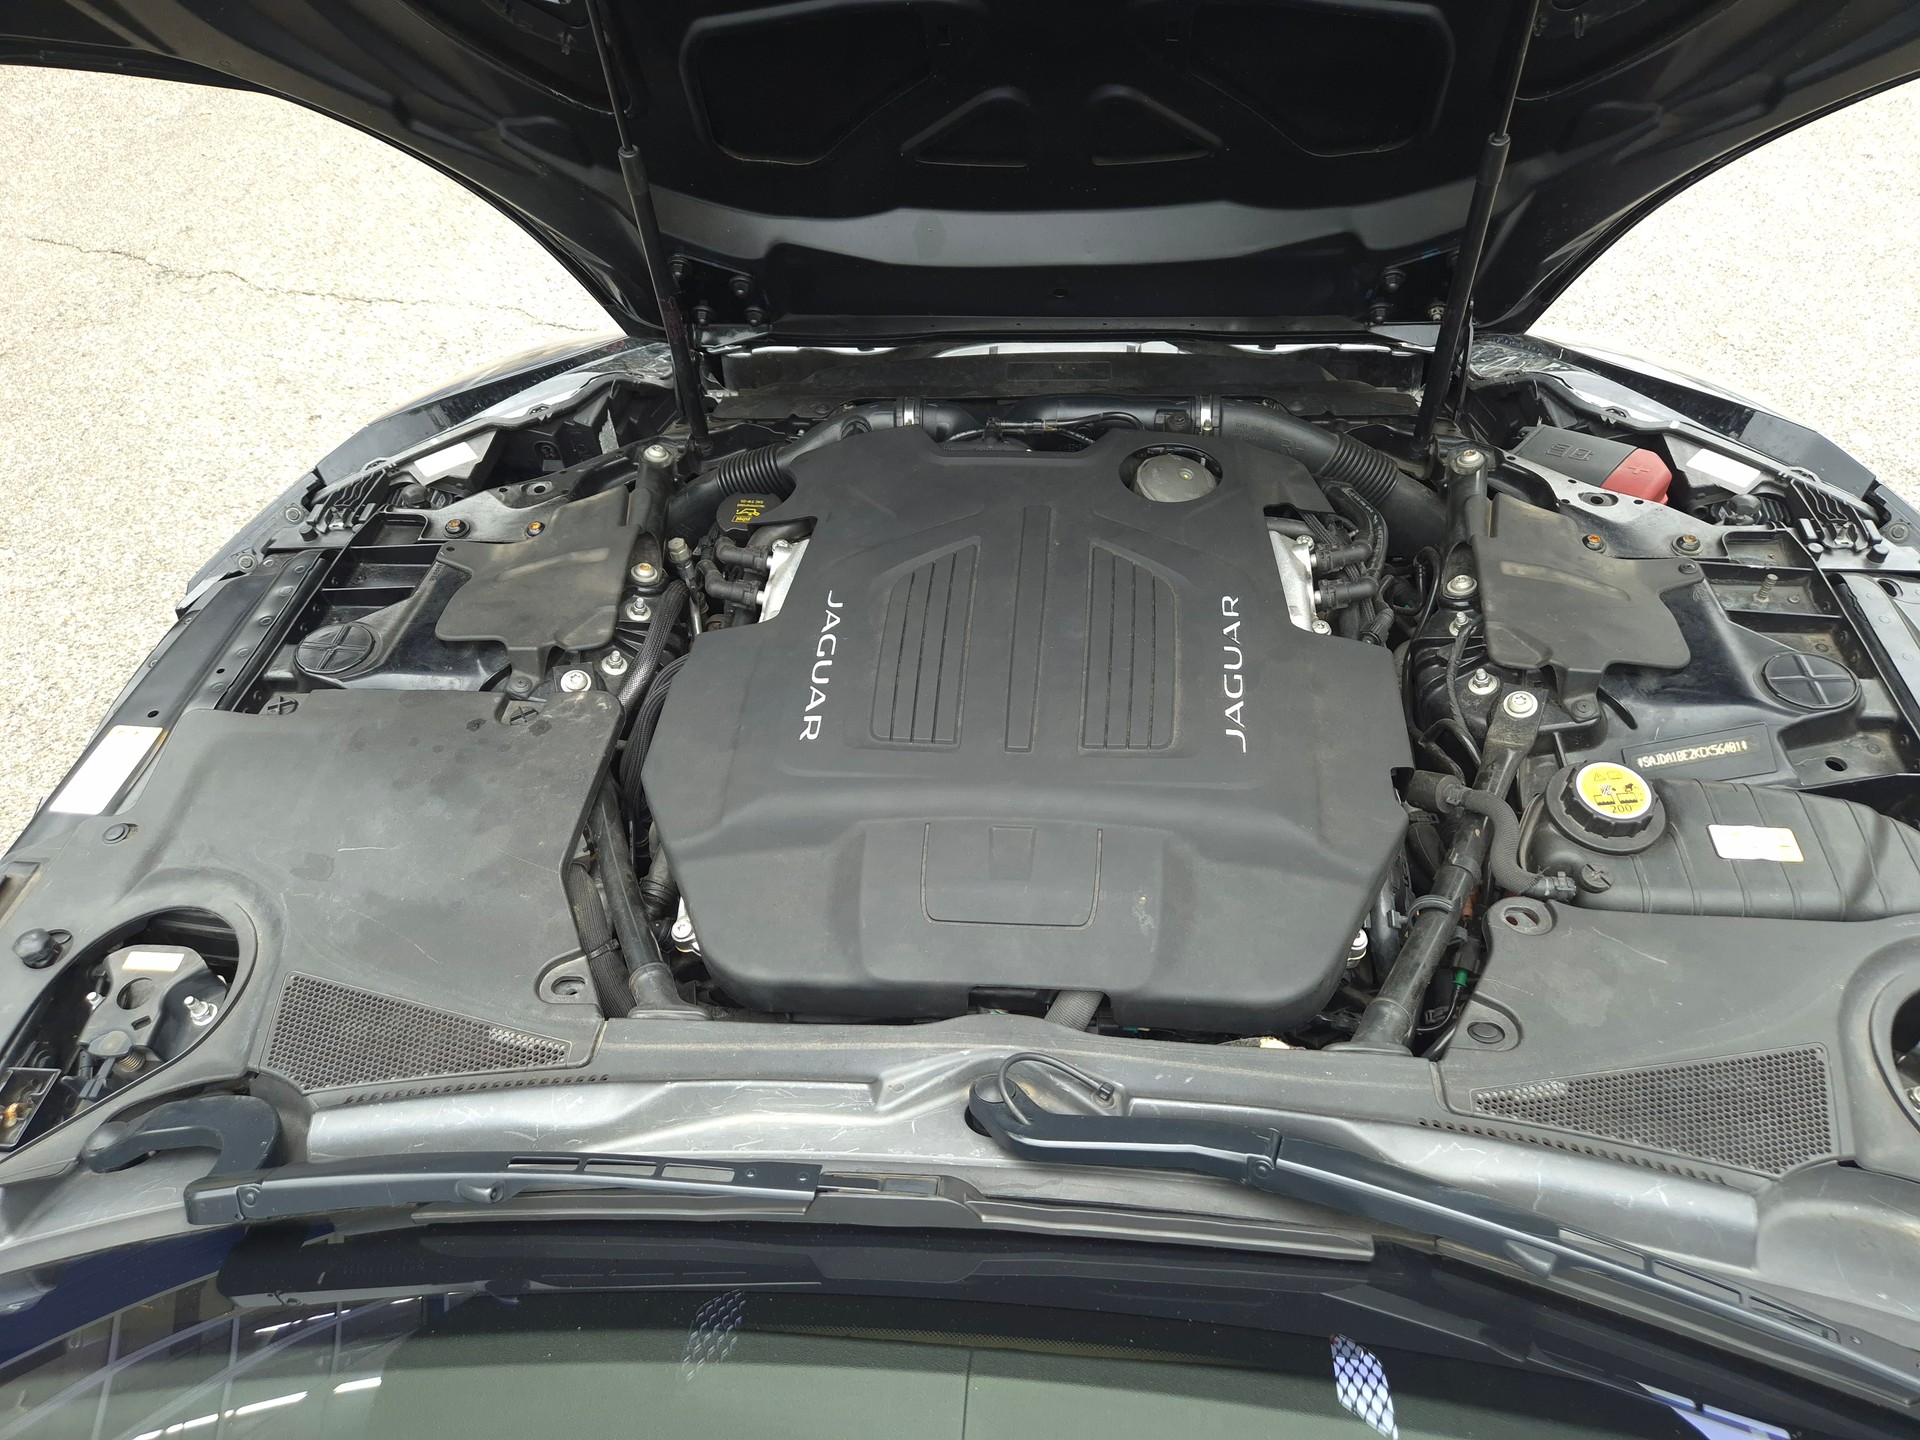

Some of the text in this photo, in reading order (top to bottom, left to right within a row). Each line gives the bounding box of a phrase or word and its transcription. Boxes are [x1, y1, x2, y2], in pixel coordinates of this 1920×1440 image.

[799, 590, 843, 740] JAGUAR
[1222, 595, 1246, 753] JAGUAR
[1610, 803, 1633, 814] 200
